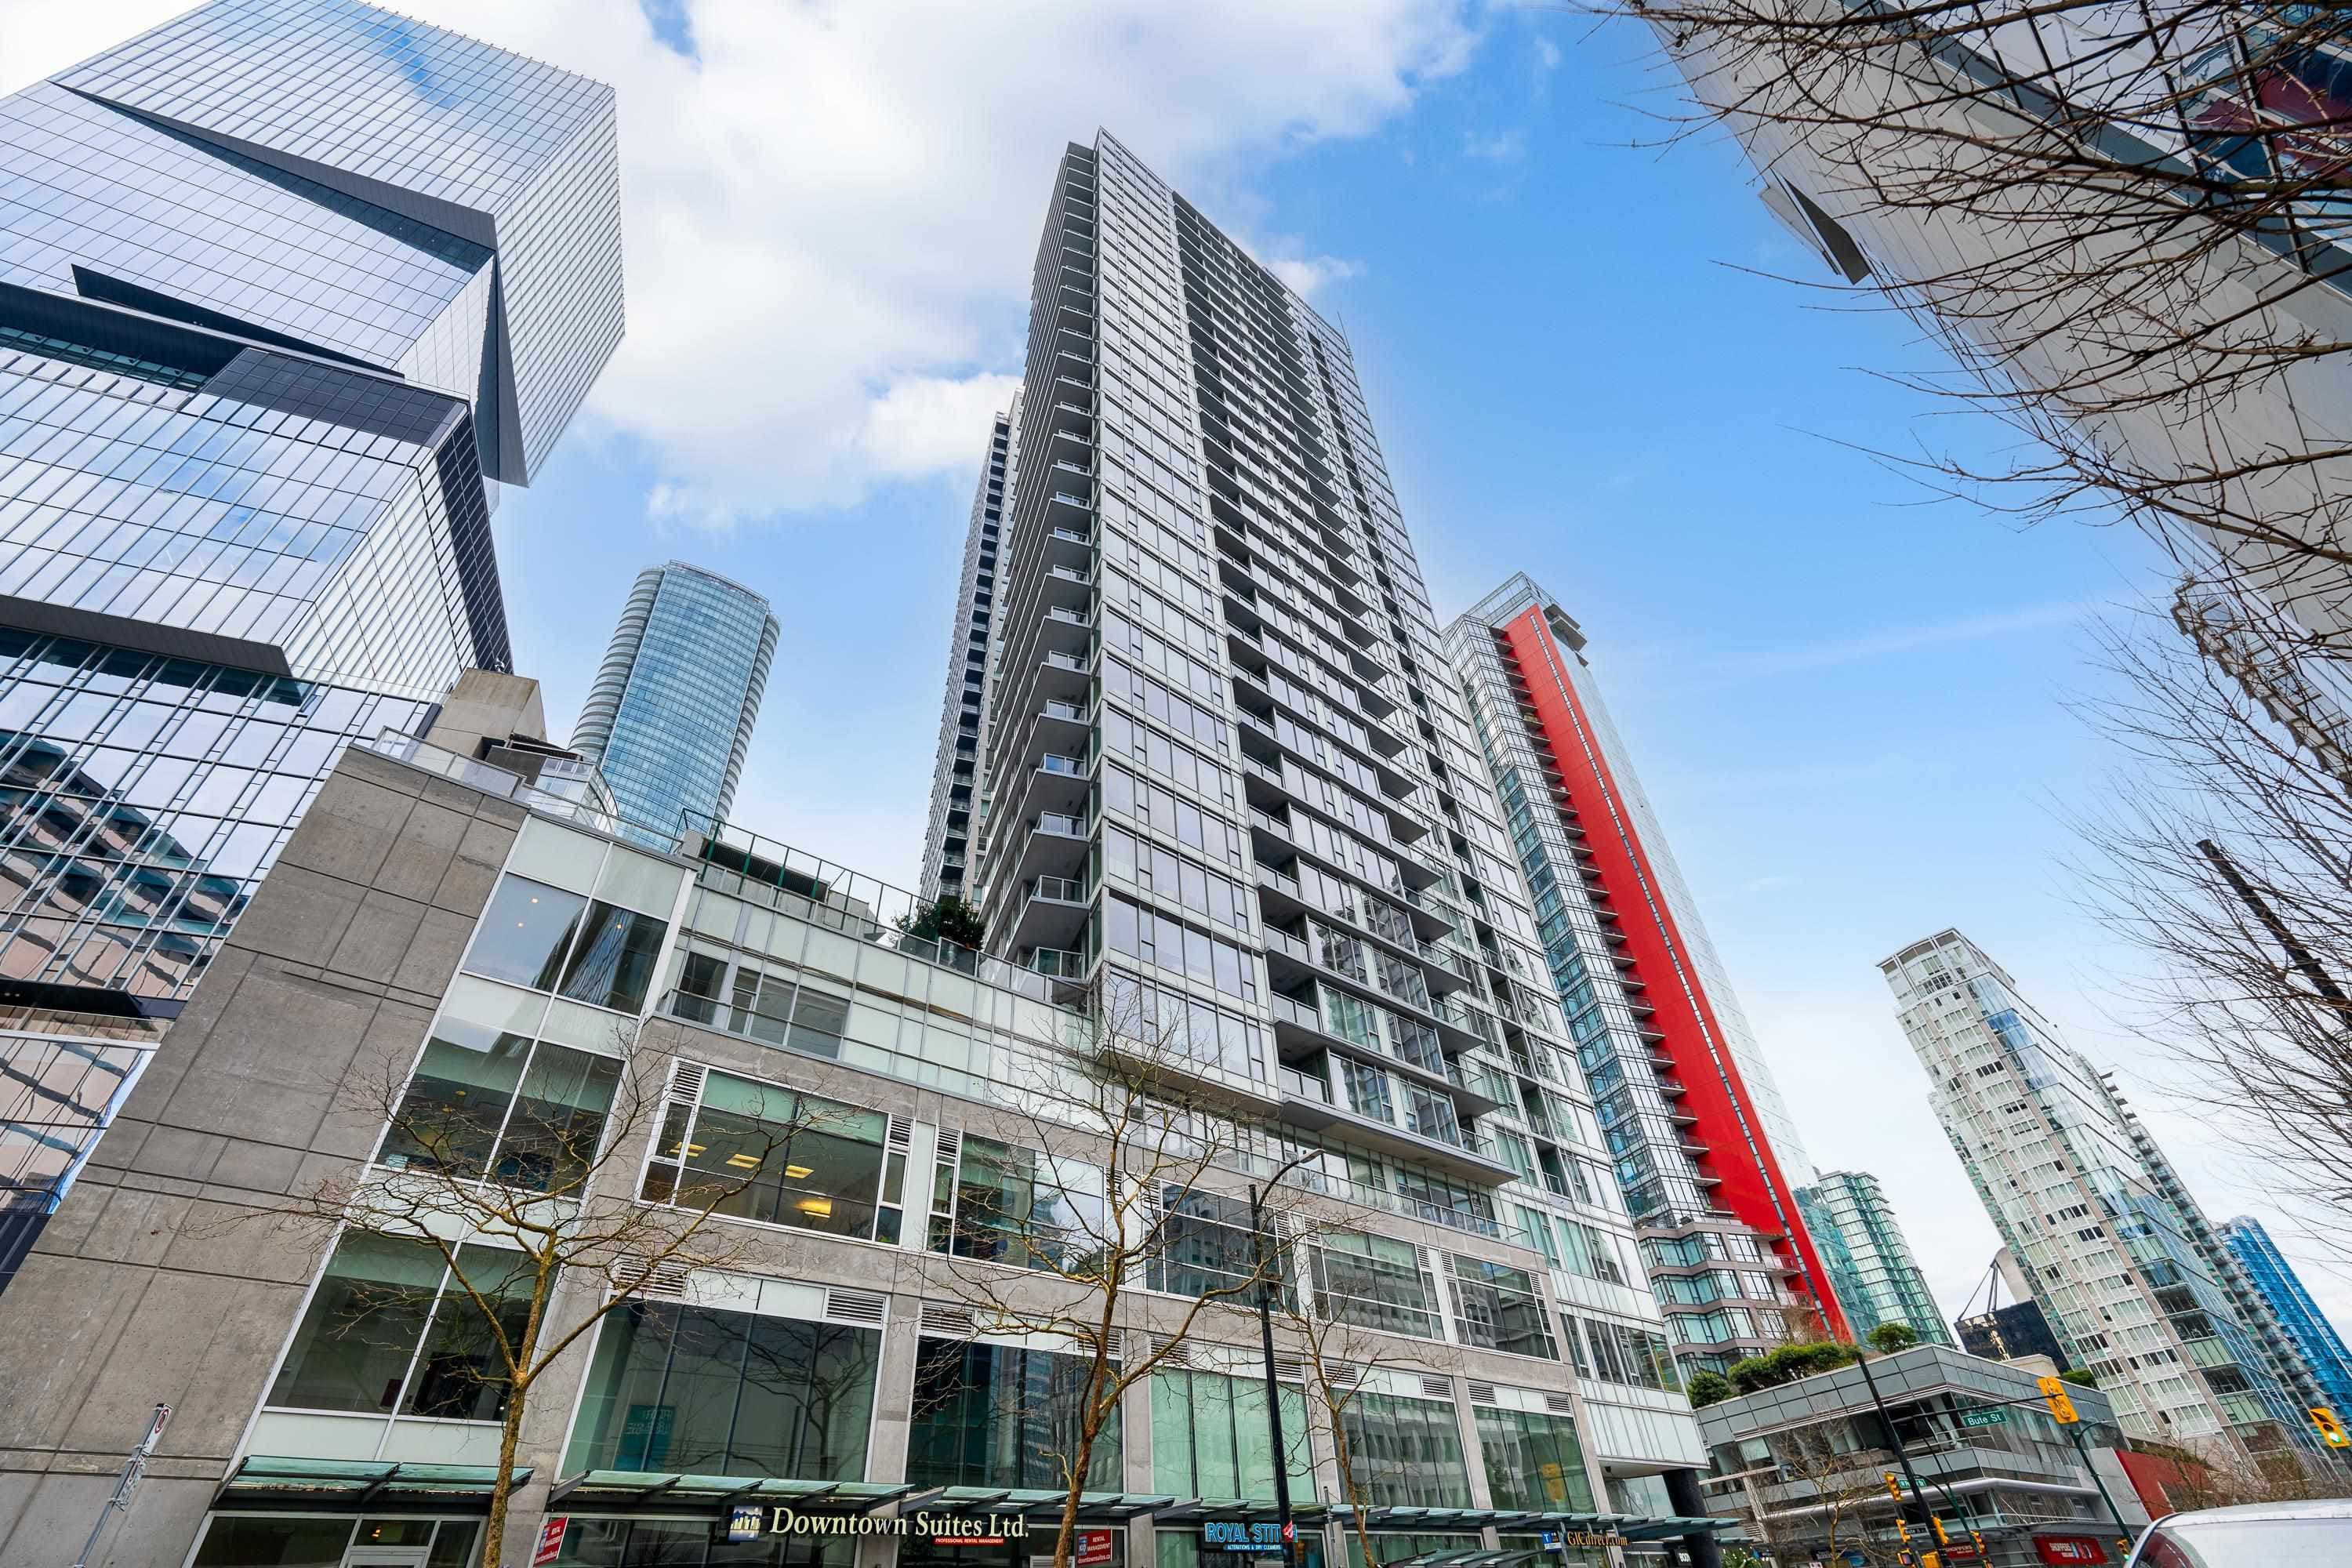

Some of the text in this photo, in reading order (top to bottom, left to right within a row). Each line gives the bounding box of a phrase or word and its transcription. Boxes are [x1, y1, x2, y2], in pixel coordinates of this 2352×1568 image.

[1968, 1414, 2002, 1425] Bute St
[769, 1507, 1029, 1537] Downtown Suites Ltd.
[1204, 1522, 1249, 1543] ROYAL
